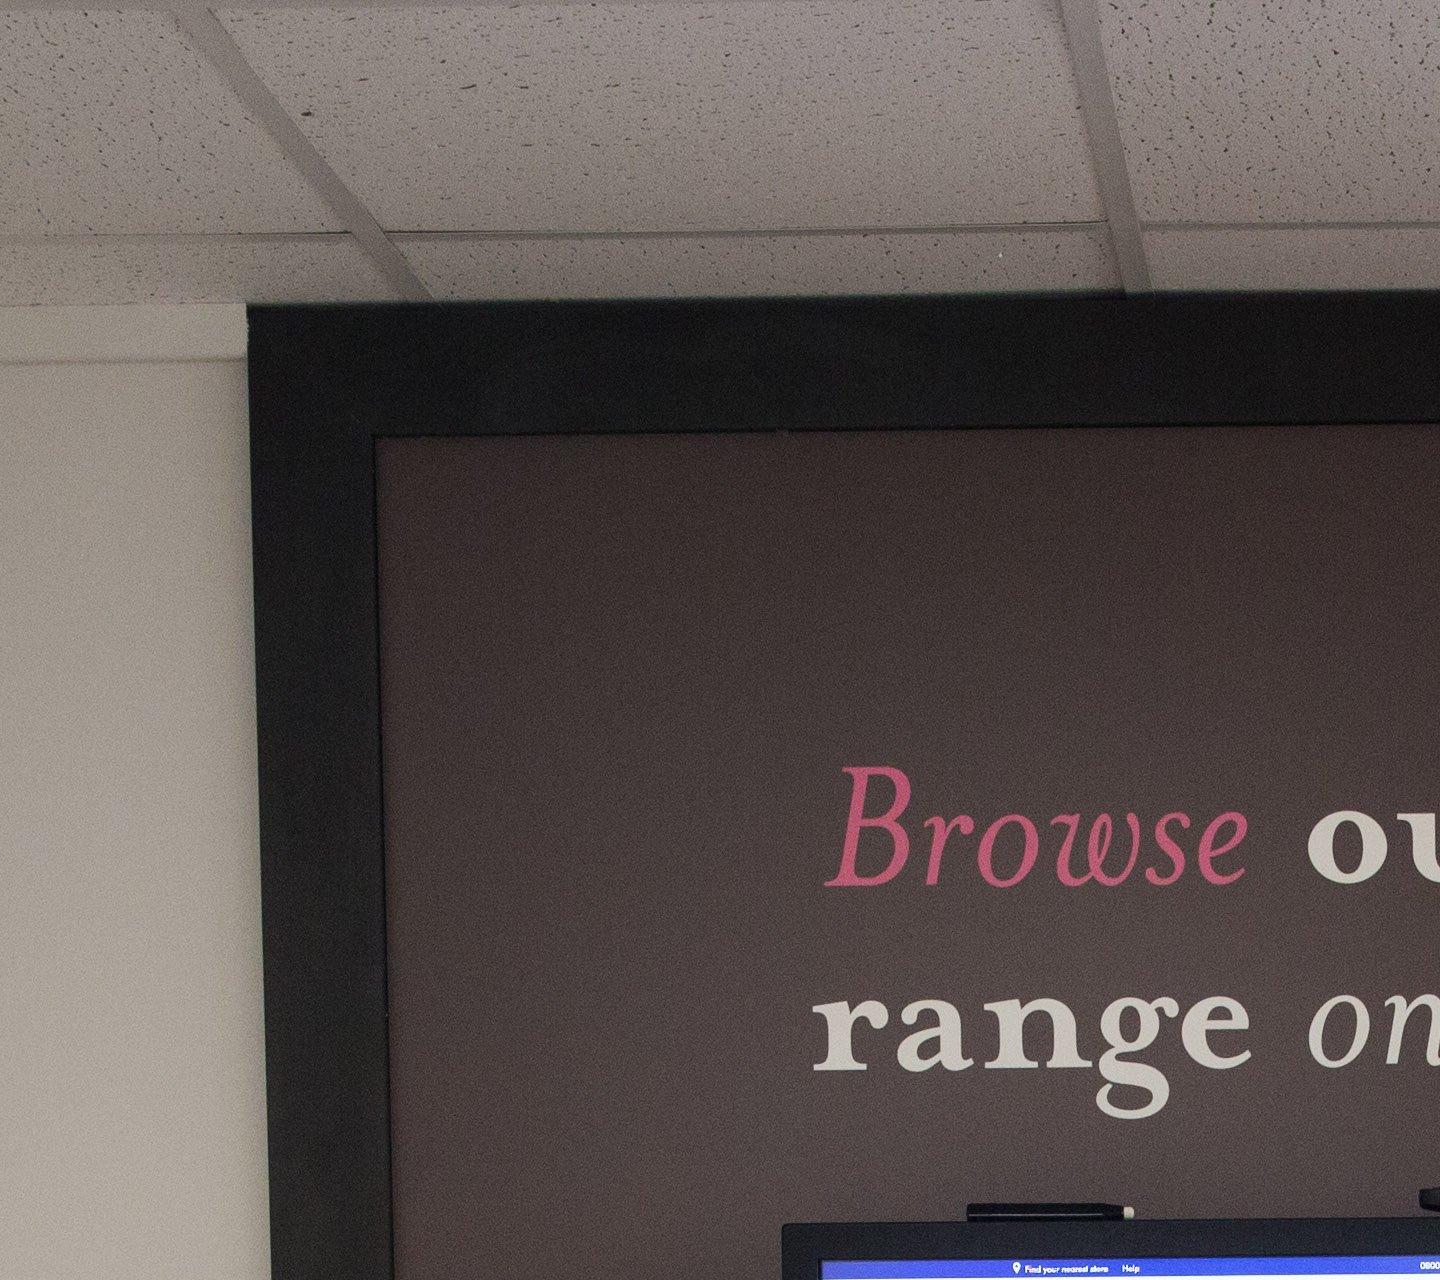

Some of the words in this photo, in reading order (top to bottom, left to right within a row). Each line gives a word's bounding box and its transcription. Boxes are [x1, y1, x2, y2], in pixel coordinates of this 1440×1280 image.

[823, 764, 1251, 891] Browse
[811, 990, 1254, 1120] range
[1024, 1264, 1041, 1274] Find
[1042, 1265, 1059, 1275] your
[1122, 1264, 1140, 1275] Help
[1419, 1261, 1440, 1270] 0800
